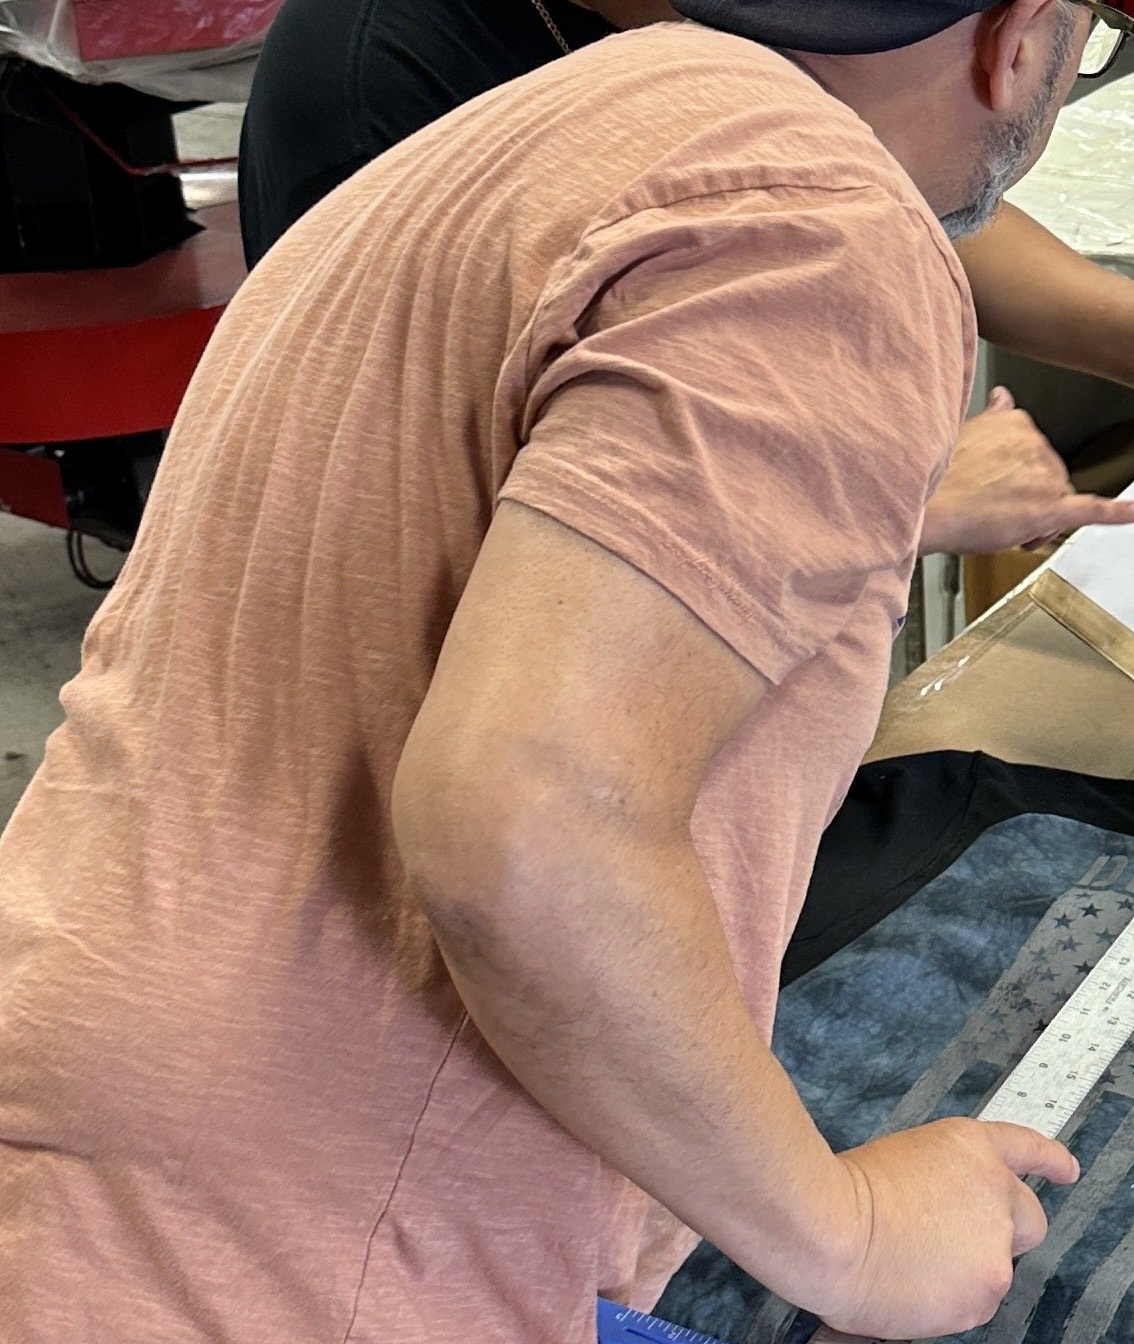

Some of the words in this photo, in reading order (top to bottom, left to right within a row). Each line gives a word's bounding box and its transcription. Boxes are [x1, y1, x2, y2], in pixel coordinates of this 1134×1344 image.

[1058, 1033, 1072, 1043] 10
[1079, 1007, 1091, 1016] 11
[1099, 981, 1111, 991] 12
[1118, 957, 1131, 966] 13
[1107, 1016, 1120, 1026] 13
[1088, 1043, 1100, 1052] 14
[1066, 1070, 1080, 1080] 15
[1044, 1100, 1058, 1110] 16
